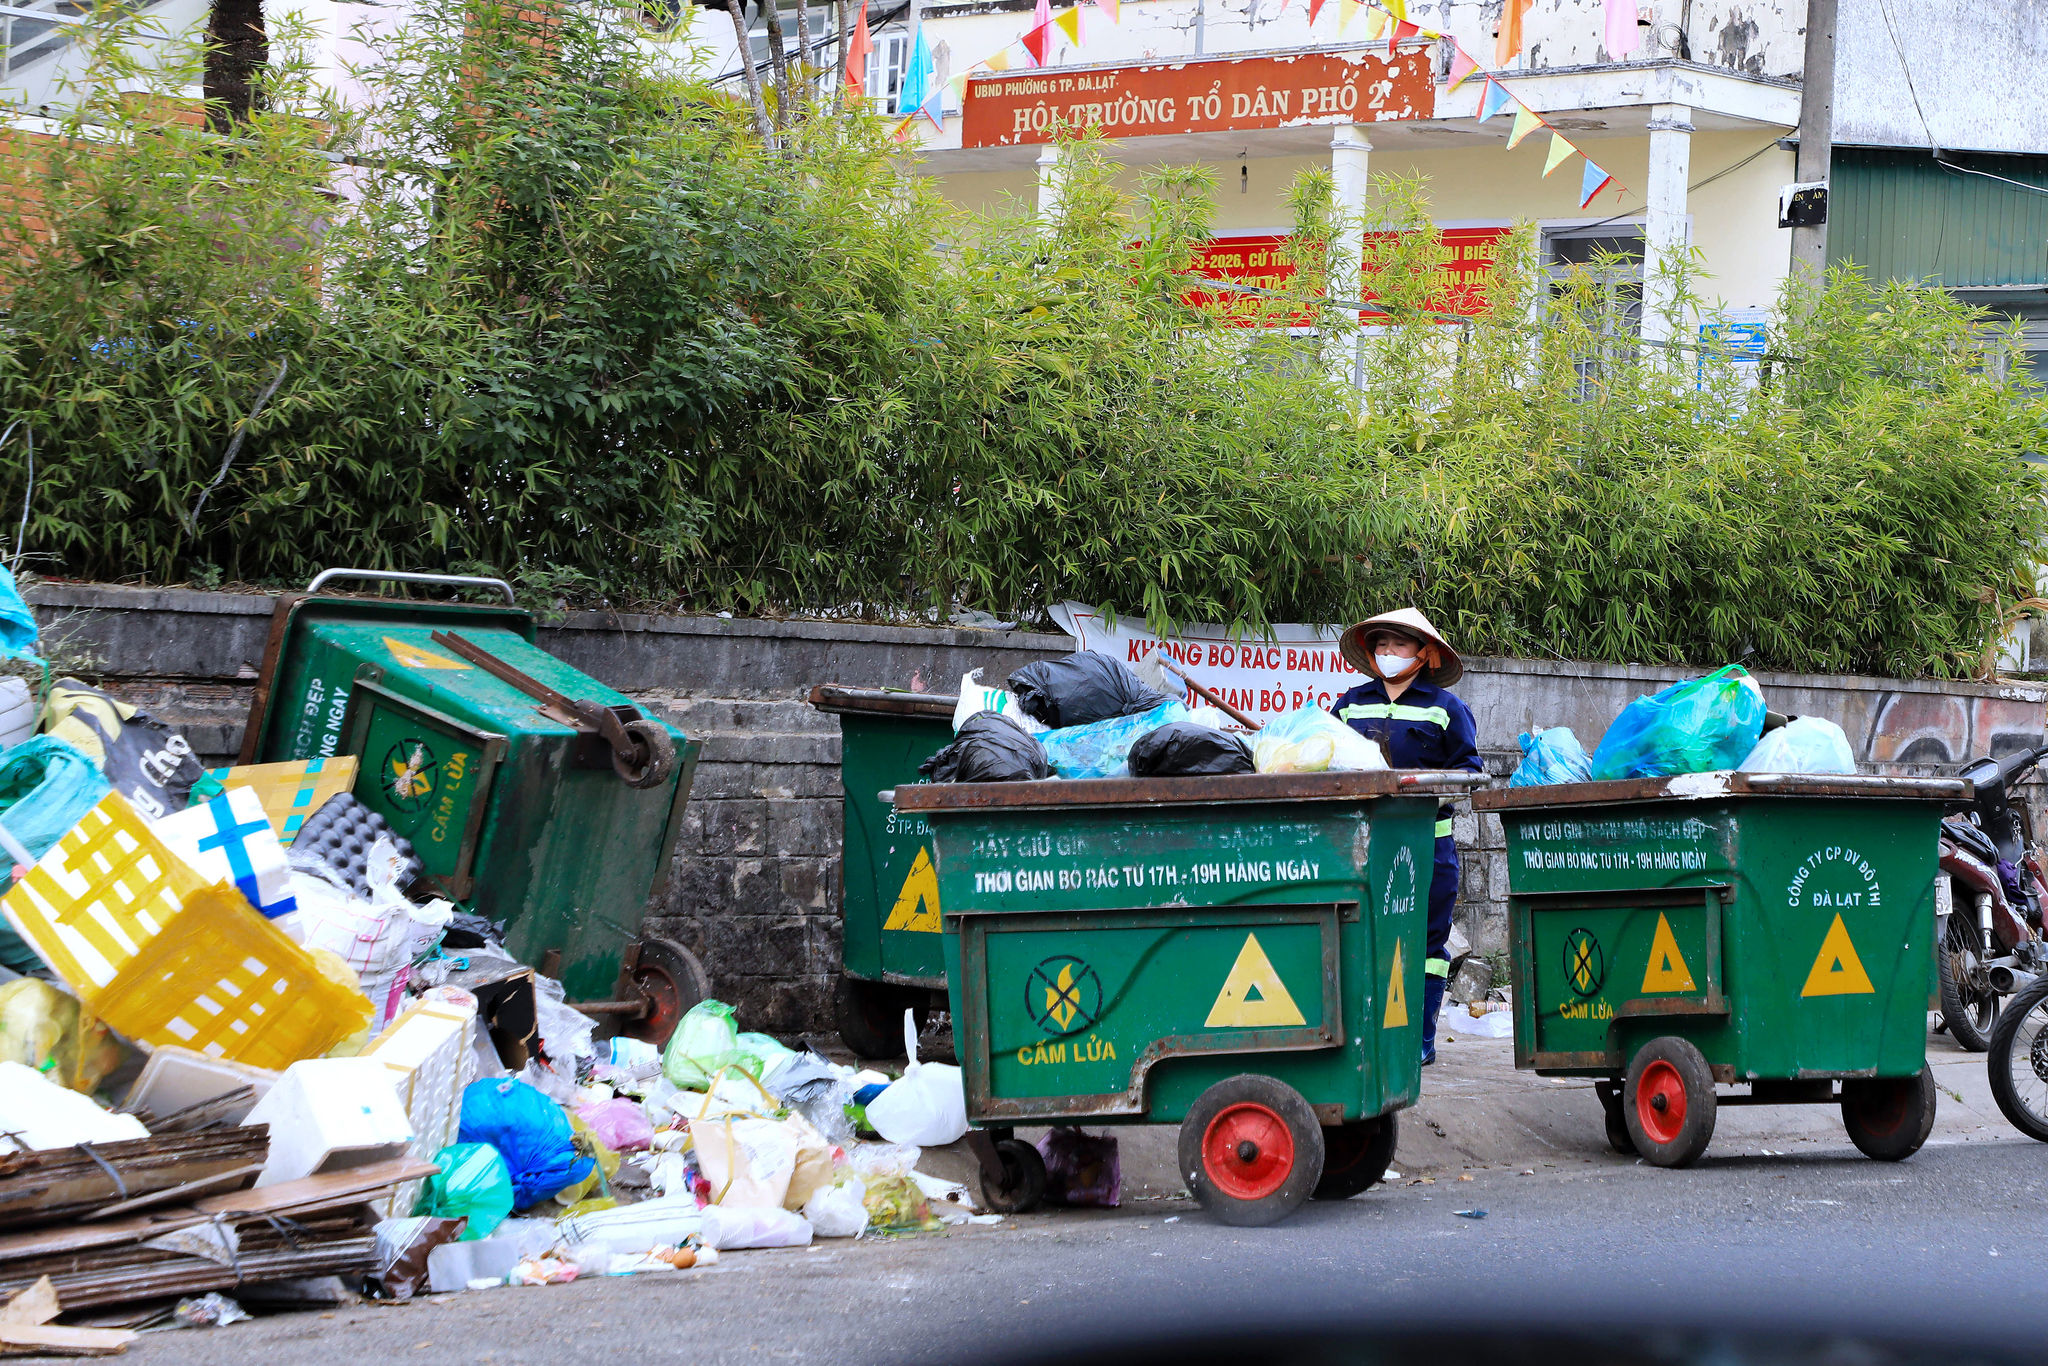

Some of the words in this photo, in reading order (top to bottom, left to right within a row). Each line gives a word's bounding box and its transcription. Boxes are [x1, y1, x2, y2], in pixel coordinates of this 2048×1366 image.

[975, 83, 1002, 98] UBND
[1005, 78, 1047, 96] PHƯỜNG
[1050, 81, 1056, 93] 6
[1059, 79, 1075, 92] TP.
[1013, 100, 1058, 136] HỘI
[1069, 90, 1176, 128] TRƯỜNG
[1187, 80, 1222, 120] TỔ
[1231, 85, 1290, 118] DÂN
[1301, 70, 1360, 113] PHỐ
[1368, 81, 1385, 109] 2
[1248, 248, 1269, 267] CỬ
[1287, 648, 1324, 672] BAN
[1260, 681, 1286, 713] BỎ
[319, 733, 338, 758] NG
[1545, 852, 1566, 869] GIAN
[1613, 852, 1629, 869] 17H
[1636, 852, 1652, 869] 19H
[1682, 847, 1706, 869] NGÀY
[1015, 869, 1054, 892] GIAN
[1149, 865, 1177, 886] 17H
[1191, 863, 1220, 883] 19H
[1788, 866, 1810, 907] CÔNG
[1807, 850, 1822, 869] TY
[1826, 846, 1841, 861] CP
[1844, 848, 1860, 865] DV
[1858, 860, 1876, 881] ĐÔ
[1868, 881, 1880, 906] THỊ
[1813, 889, 1832, 907] ĐÀ
[1836, 892, 1862, 909] LẠT
[1560, 997, 1588, 1019] CẤM
[1591, 997, 1613, 1019] LỬA
[1018, 1038, 1066, 1065] CẤM
[1074, 1034, 1116, 1062] LỬA
